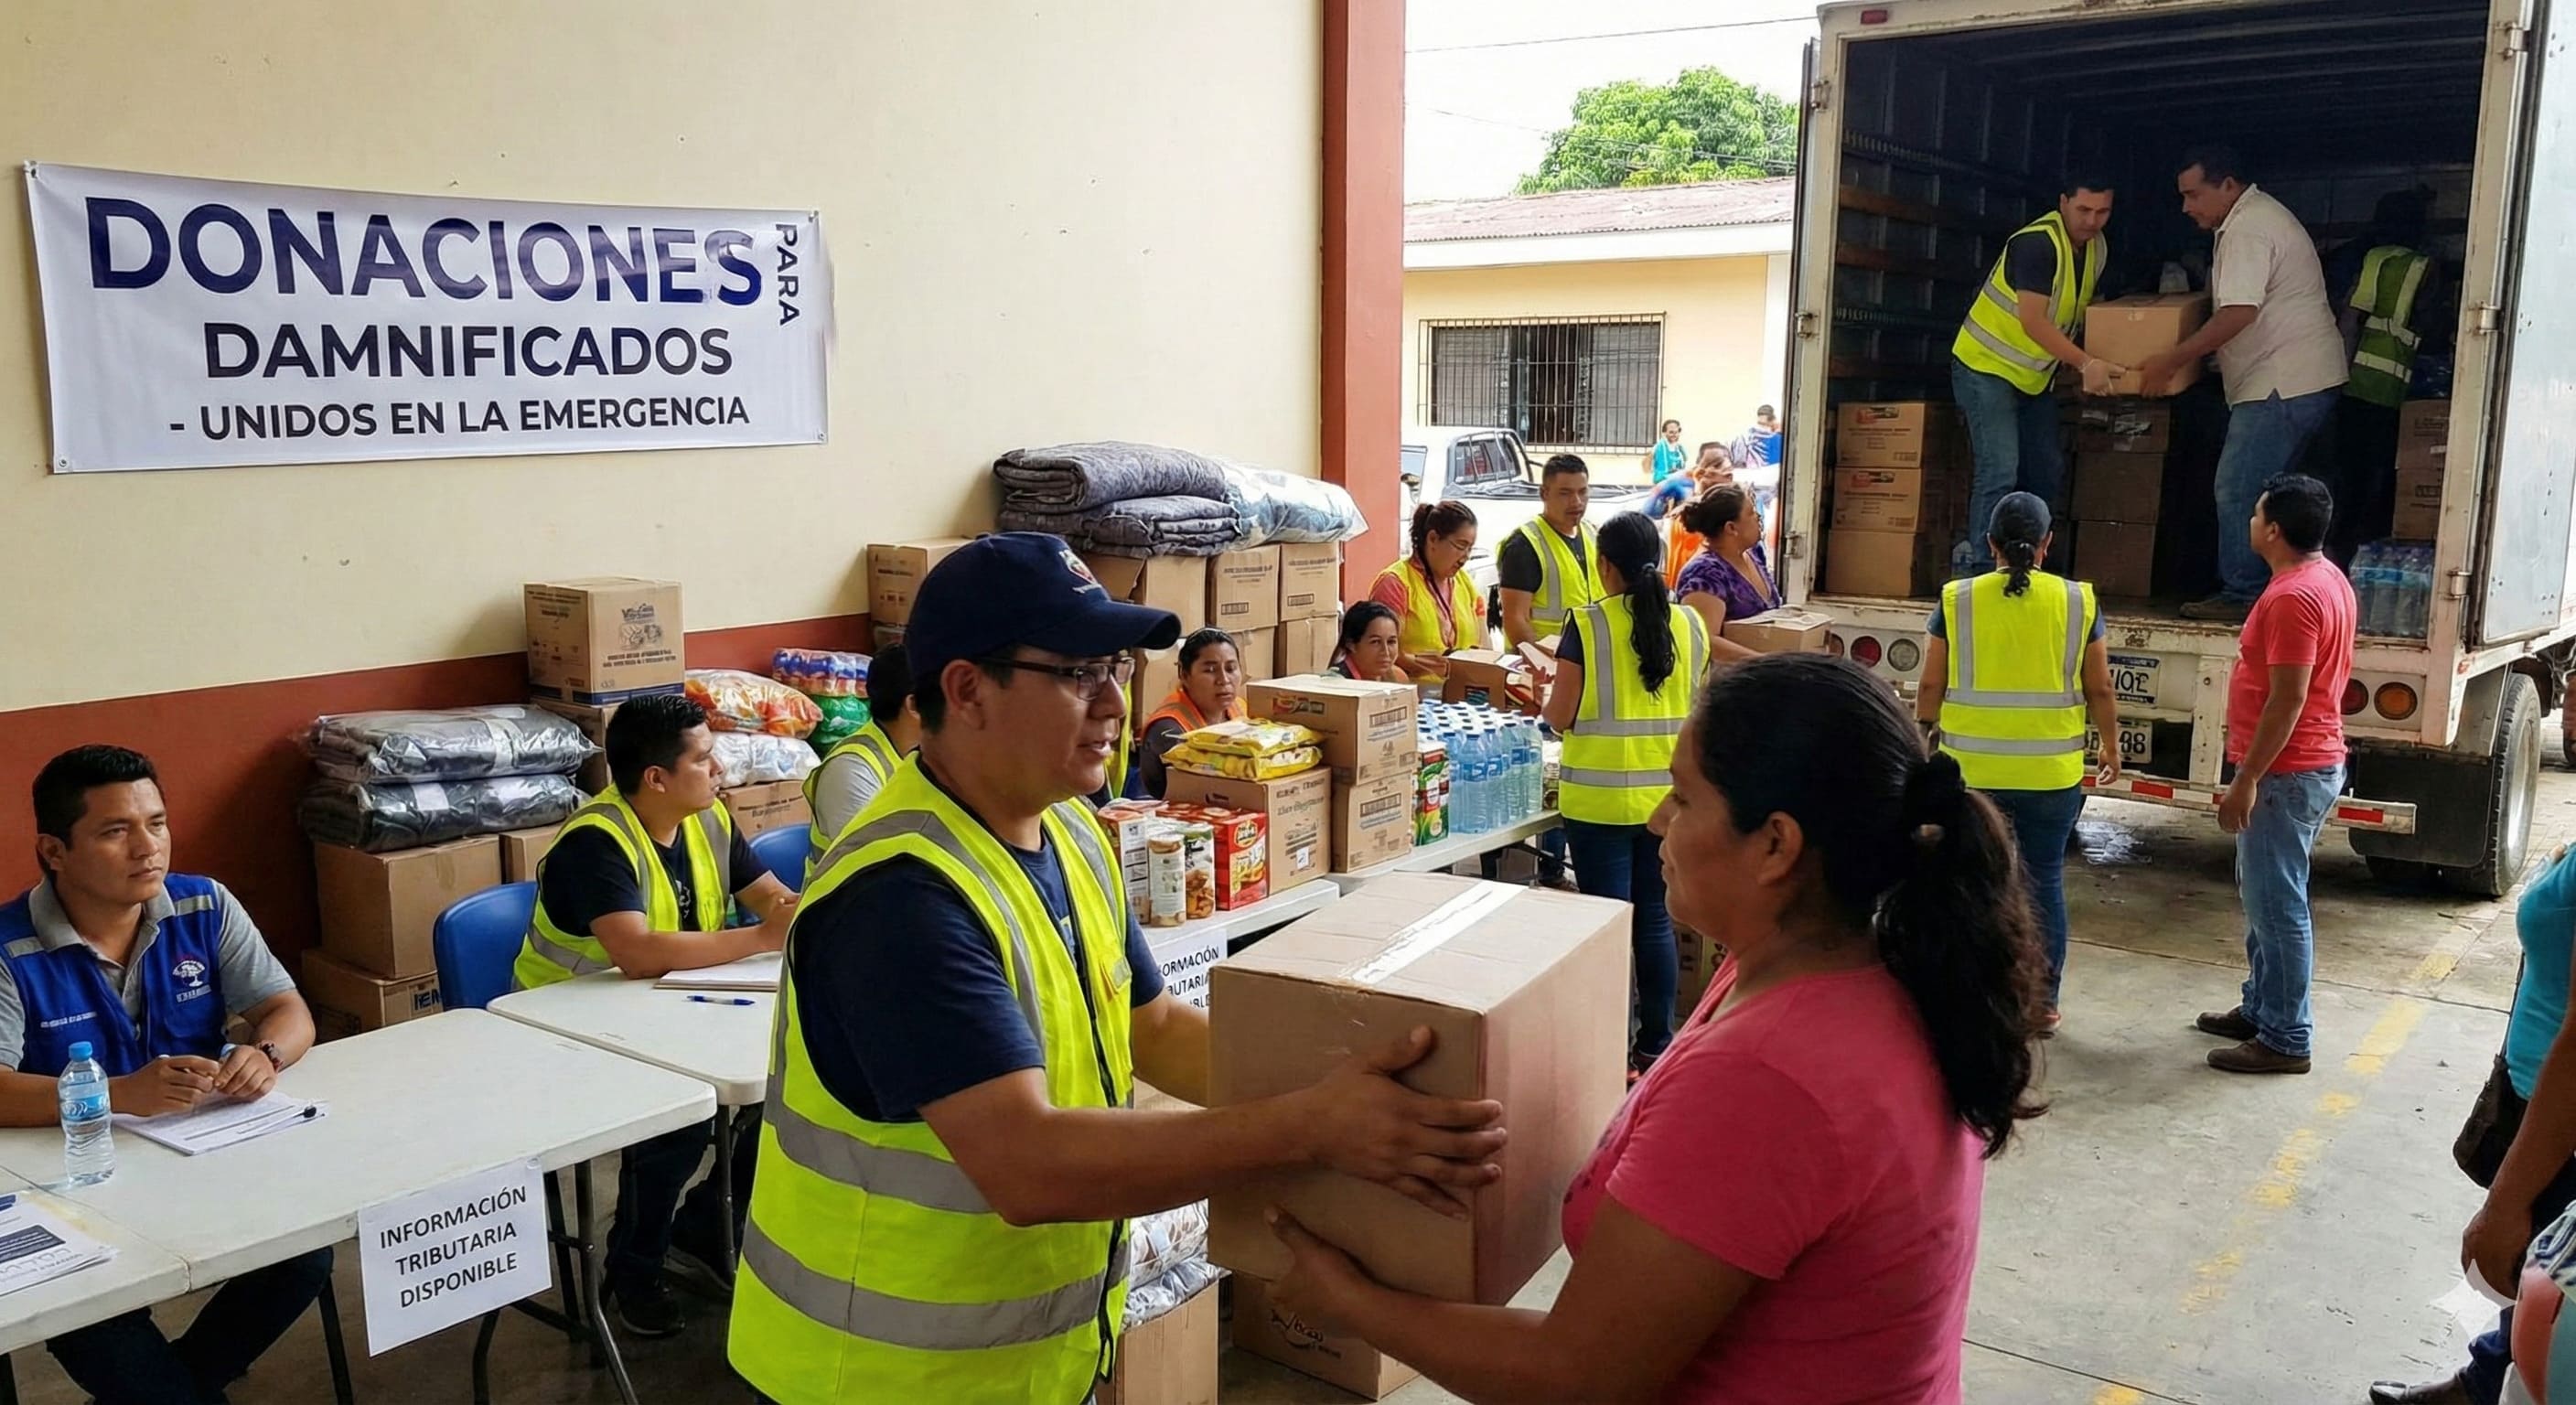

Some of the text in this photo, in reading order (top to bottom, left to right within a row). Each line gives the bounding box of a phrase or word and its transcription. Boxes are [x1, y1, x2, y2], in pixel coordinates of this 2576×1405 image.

[84, 196, 763, 307] DONACIONES
[775, 223, 800, 327] PARA
[203, 322, 733, 379] DAMNIFICADOS
[199, 401, 378, 441] UNIDOS
[390, 401, 445, 434] EN
[457, 401, 510, 433] LA
[519, 396, 750, 431] EMERGENCIA
[1162, 945, 1219, 977] ORMACIÓN
[380, 1185, 527, 1249] INFORMACIÓN
[394, 1221, 518, 1276] TRIBUTARIA
[400, 1252, 519, 1309] DISPONIBLE
